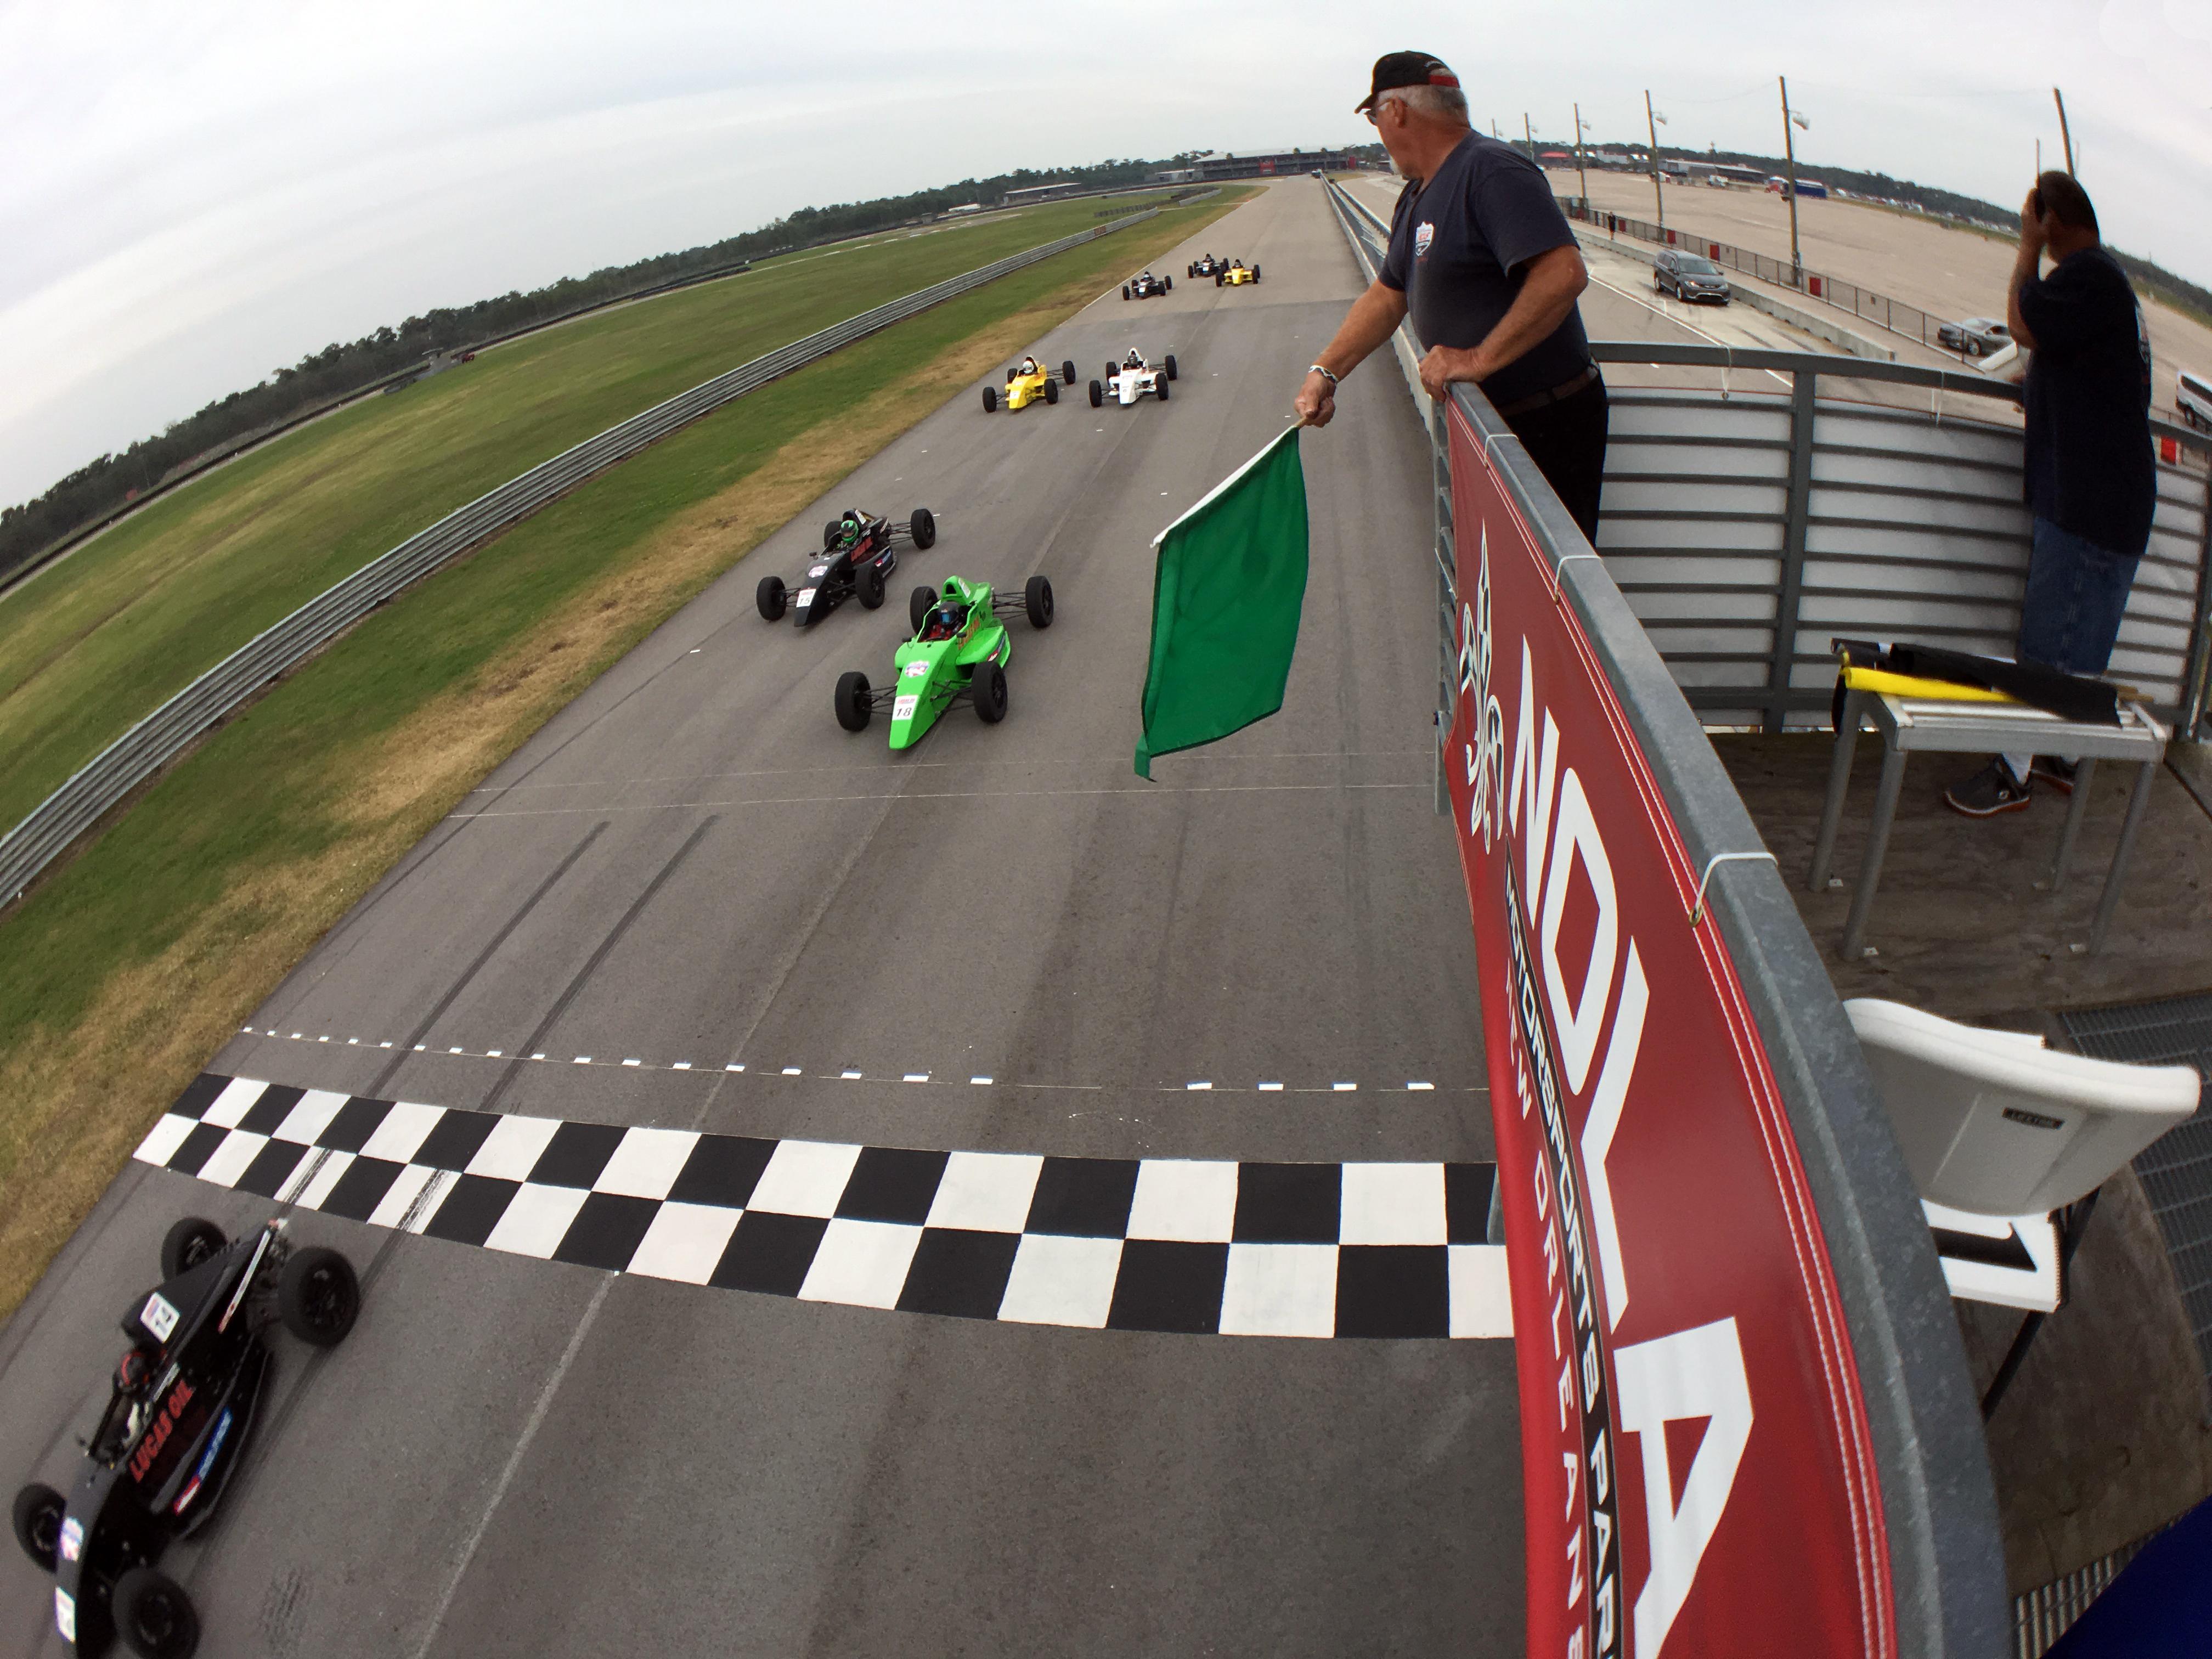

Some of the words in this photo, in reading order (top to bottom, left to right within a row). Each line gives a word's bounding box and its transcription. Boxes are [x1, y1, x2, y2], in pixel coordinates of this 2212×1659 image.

[896, 707, 912, 717] 18
[1505, 957, 1532, 1120] NEW
[1509, 634, 1754, 1659] NOLA
[1505, 861, 1600, 1414] MOTORSPORTS
[1590, 1428, 1615, 1659] PAR
[130, 1408, 173, 1482] LUCAS
[168, 1380, 196, 1420] OIL
